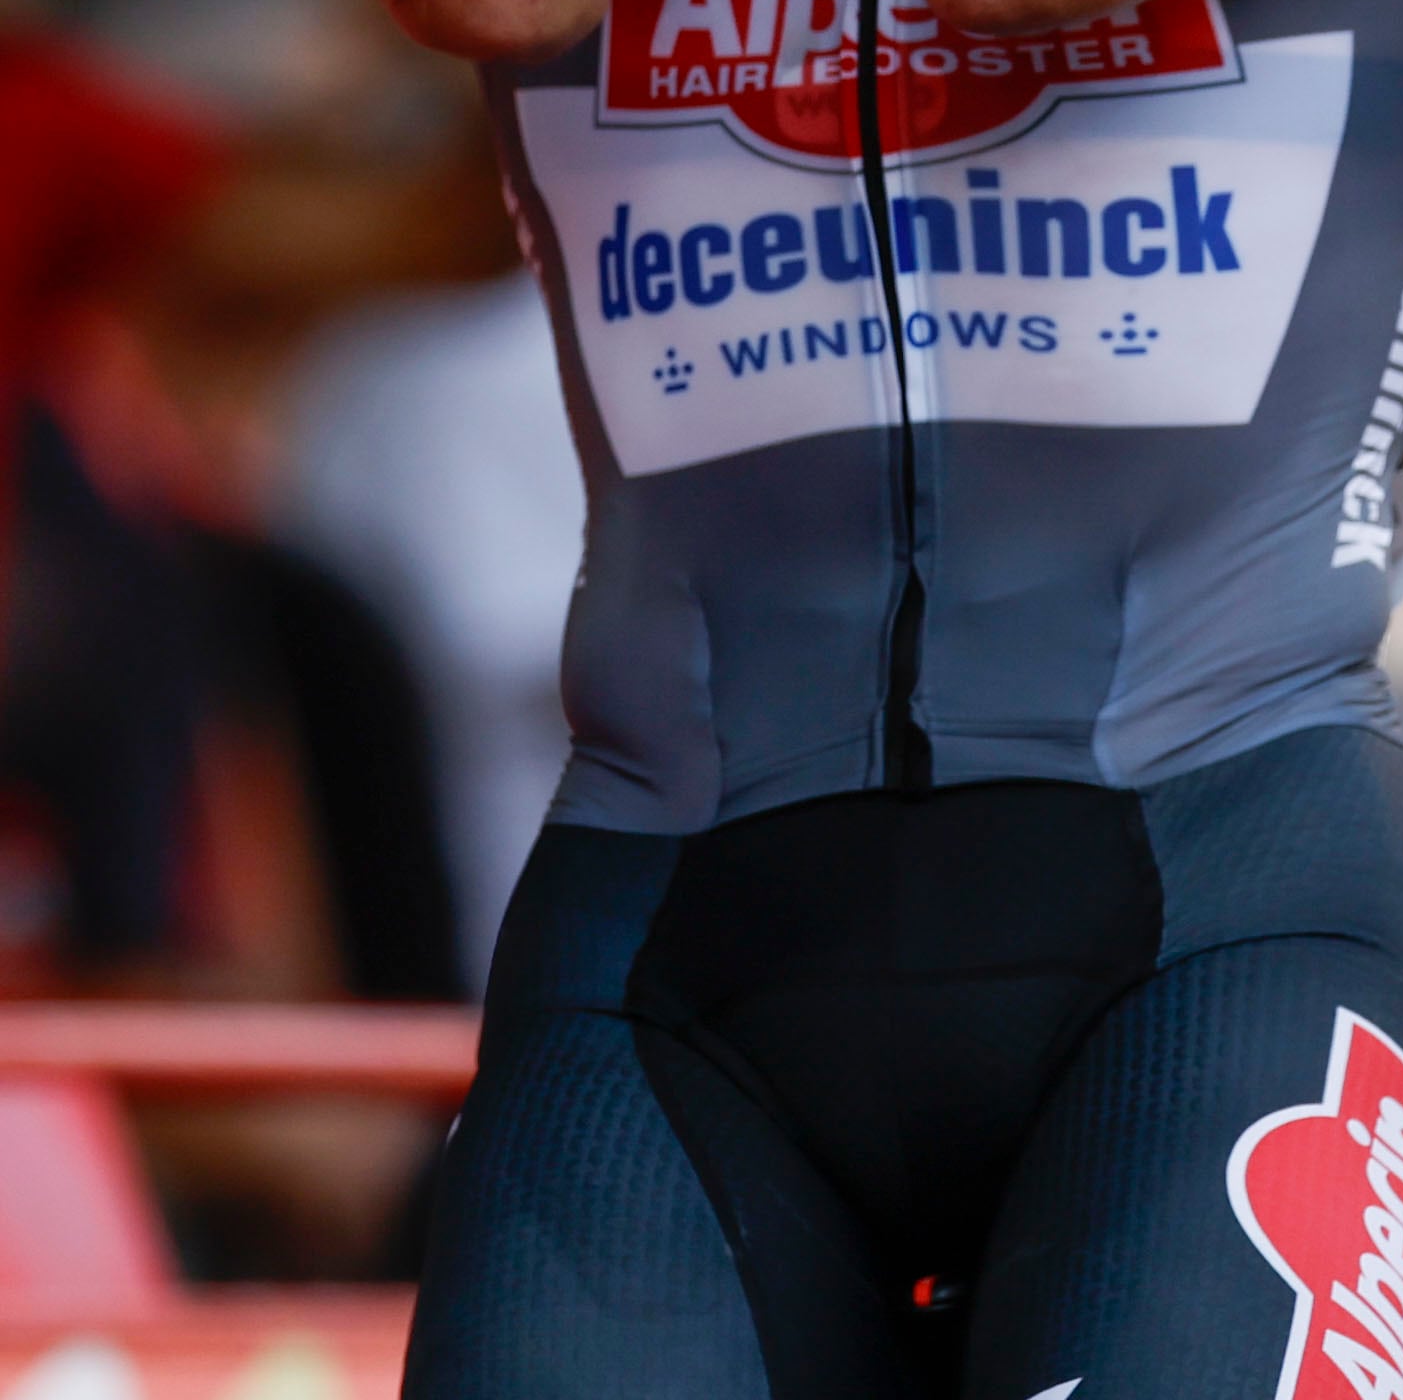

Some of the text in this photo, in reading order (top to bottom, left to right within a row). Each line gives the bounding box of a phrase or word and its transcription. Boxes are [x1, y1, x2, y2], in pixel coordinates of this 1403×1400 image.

[650, 61, 773, 98] HAIR
[598, 164, 1242, 322] deceuninck
[718, 309, 1059, 378] WINDOWS
